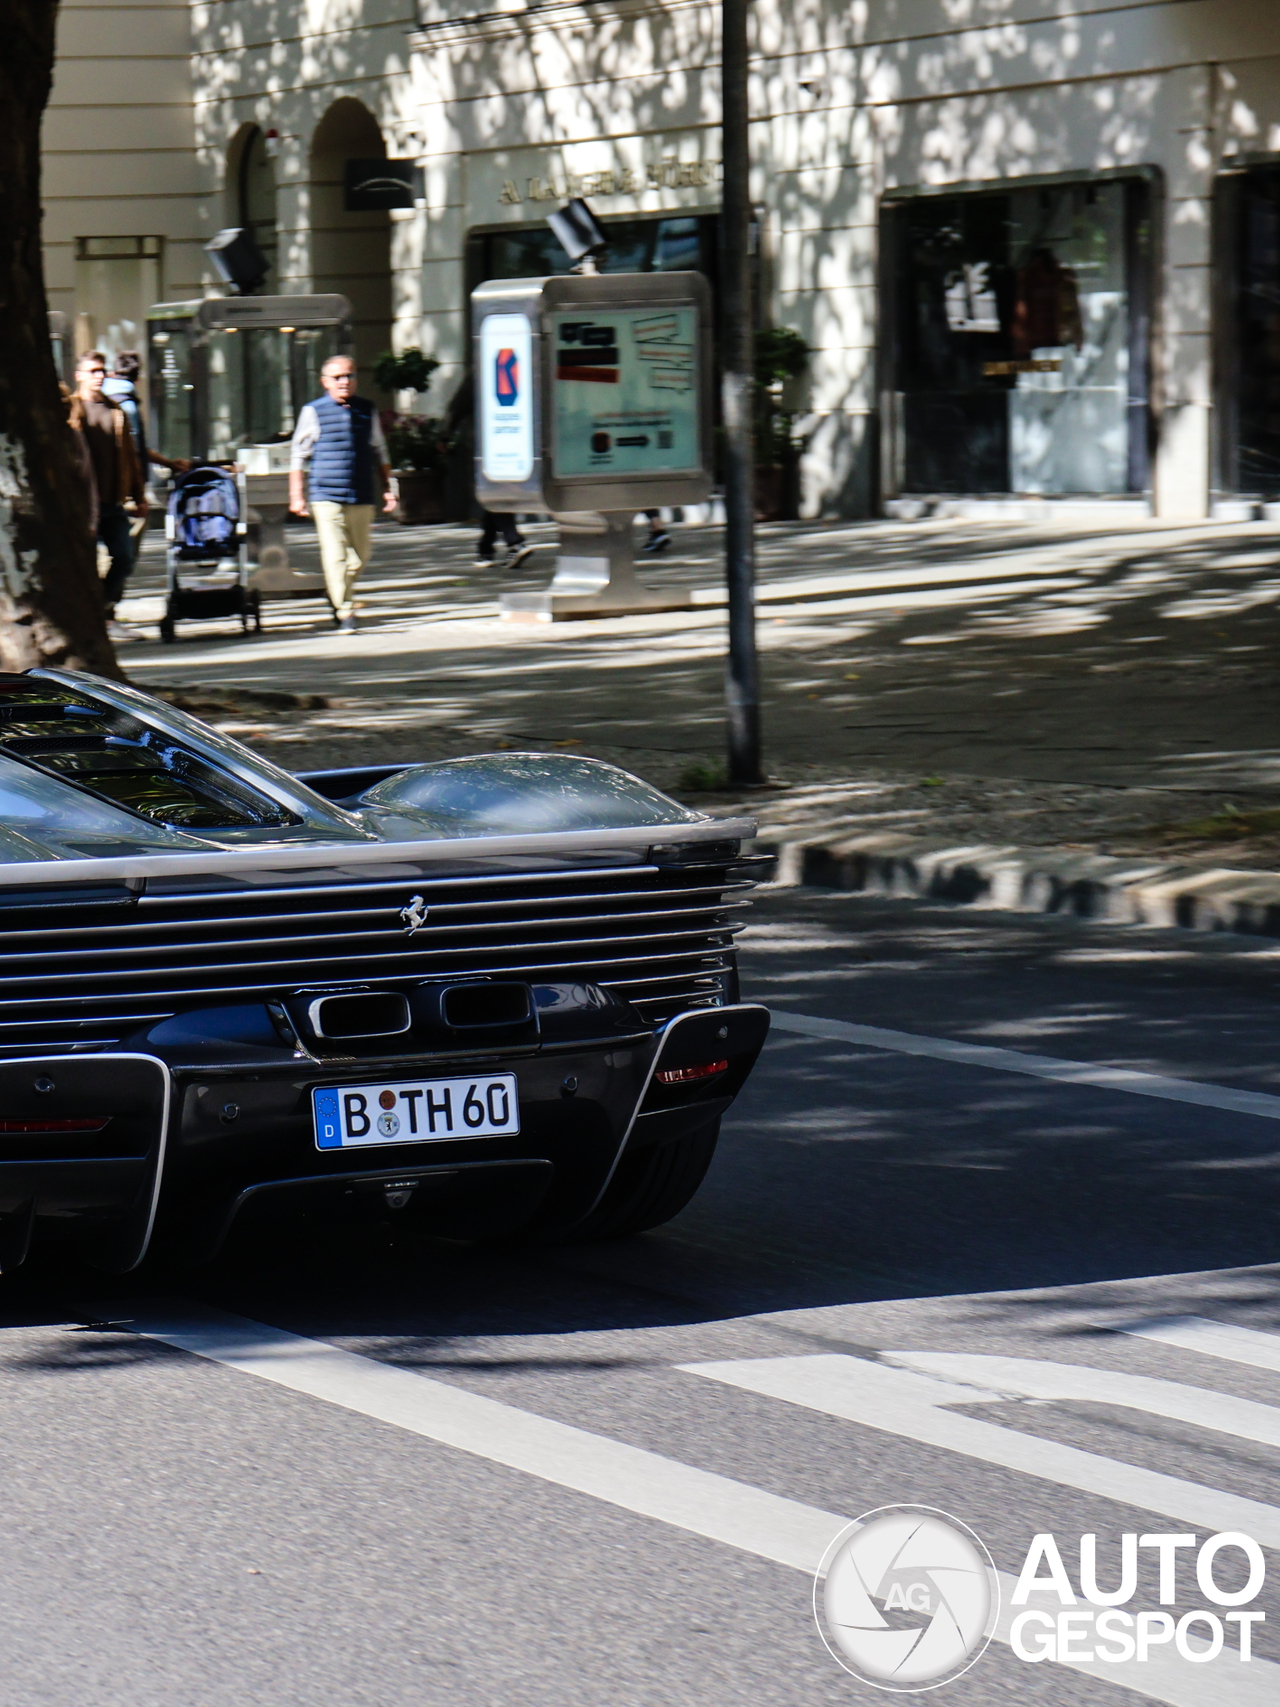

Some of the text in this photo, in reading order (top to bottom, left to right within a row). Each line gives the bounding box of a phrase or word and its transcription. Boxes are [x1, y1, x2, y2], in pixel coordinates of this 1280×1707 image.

[343, 1093, 371, 1138] B
[399, 1088, 453, 1133] TH
[463, 1083, 509, 1128] 60
[324, 1124, 335, 1138] D
